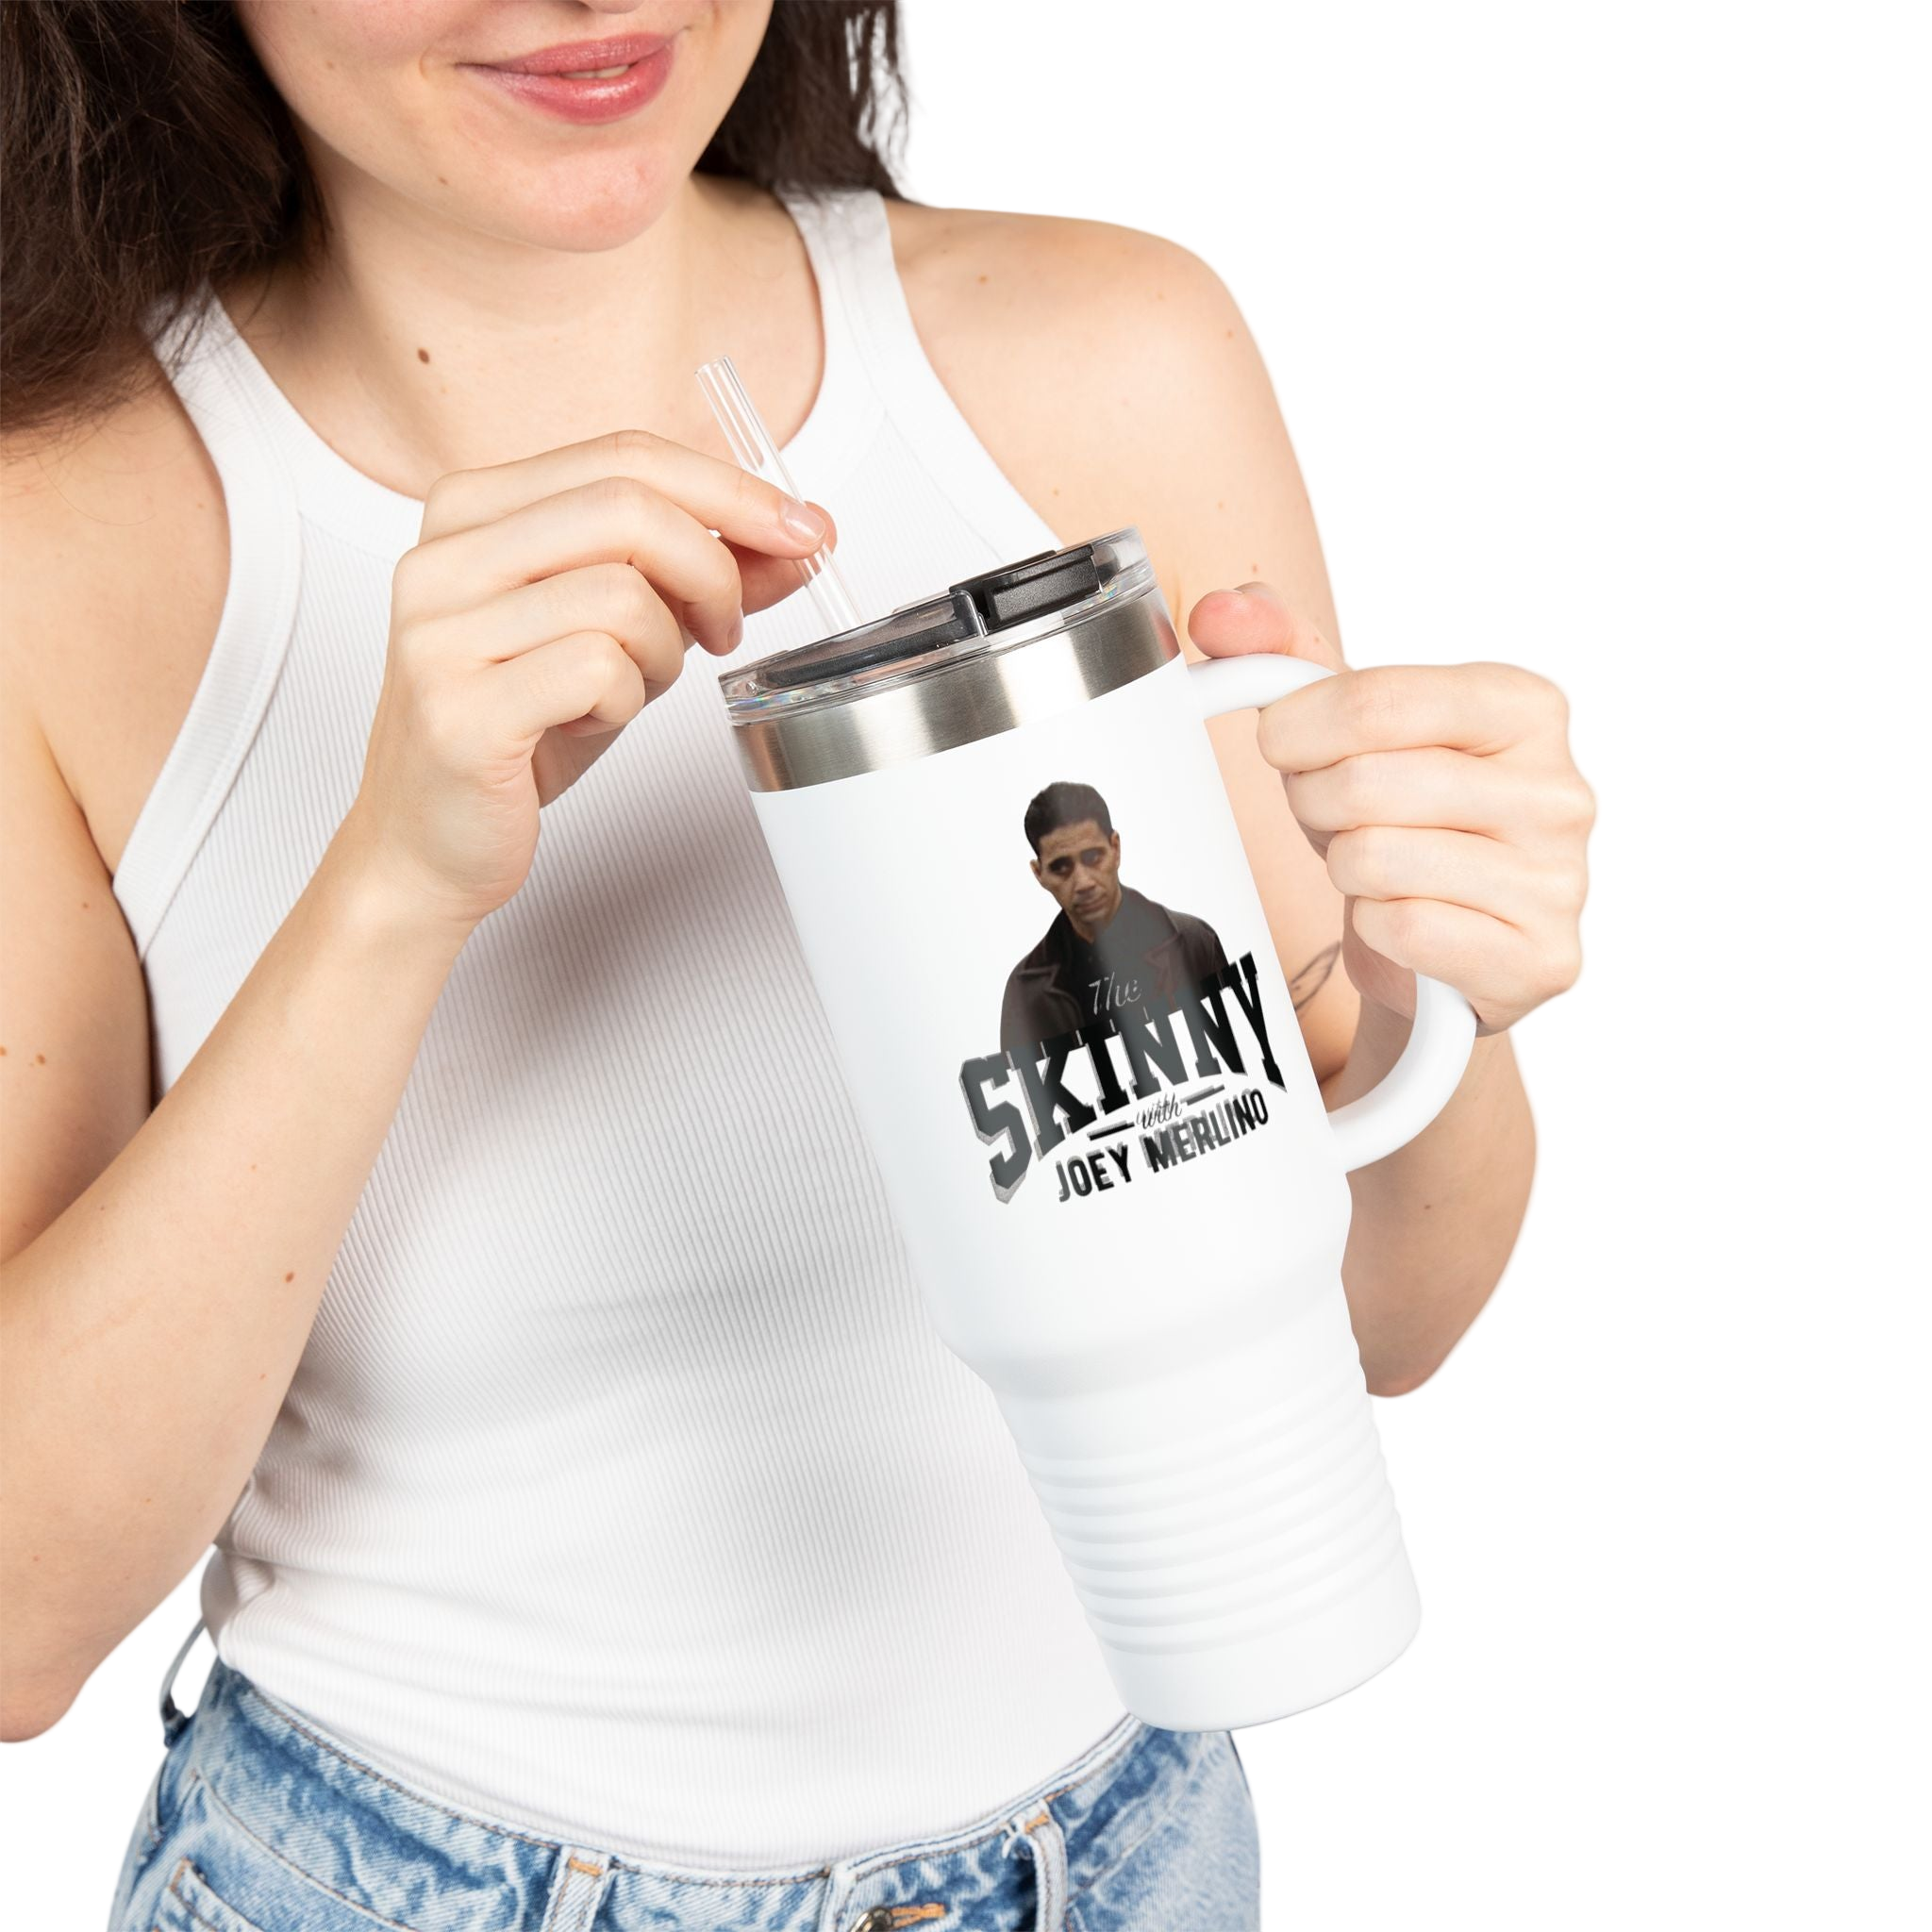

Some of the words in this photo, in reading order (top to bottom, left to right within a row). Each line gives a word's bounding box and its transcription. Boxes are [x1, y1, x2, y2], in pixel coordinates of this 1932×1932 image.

[1089, 972, 1141, 1015] The
[958, 951, 1288, 1204] SKINNY
[1136, 1092, 1182, 1130] with
[1056, 1141, 1132, 1203] JOEY
[1140, 1089, 1269, 1173] MERLINO
